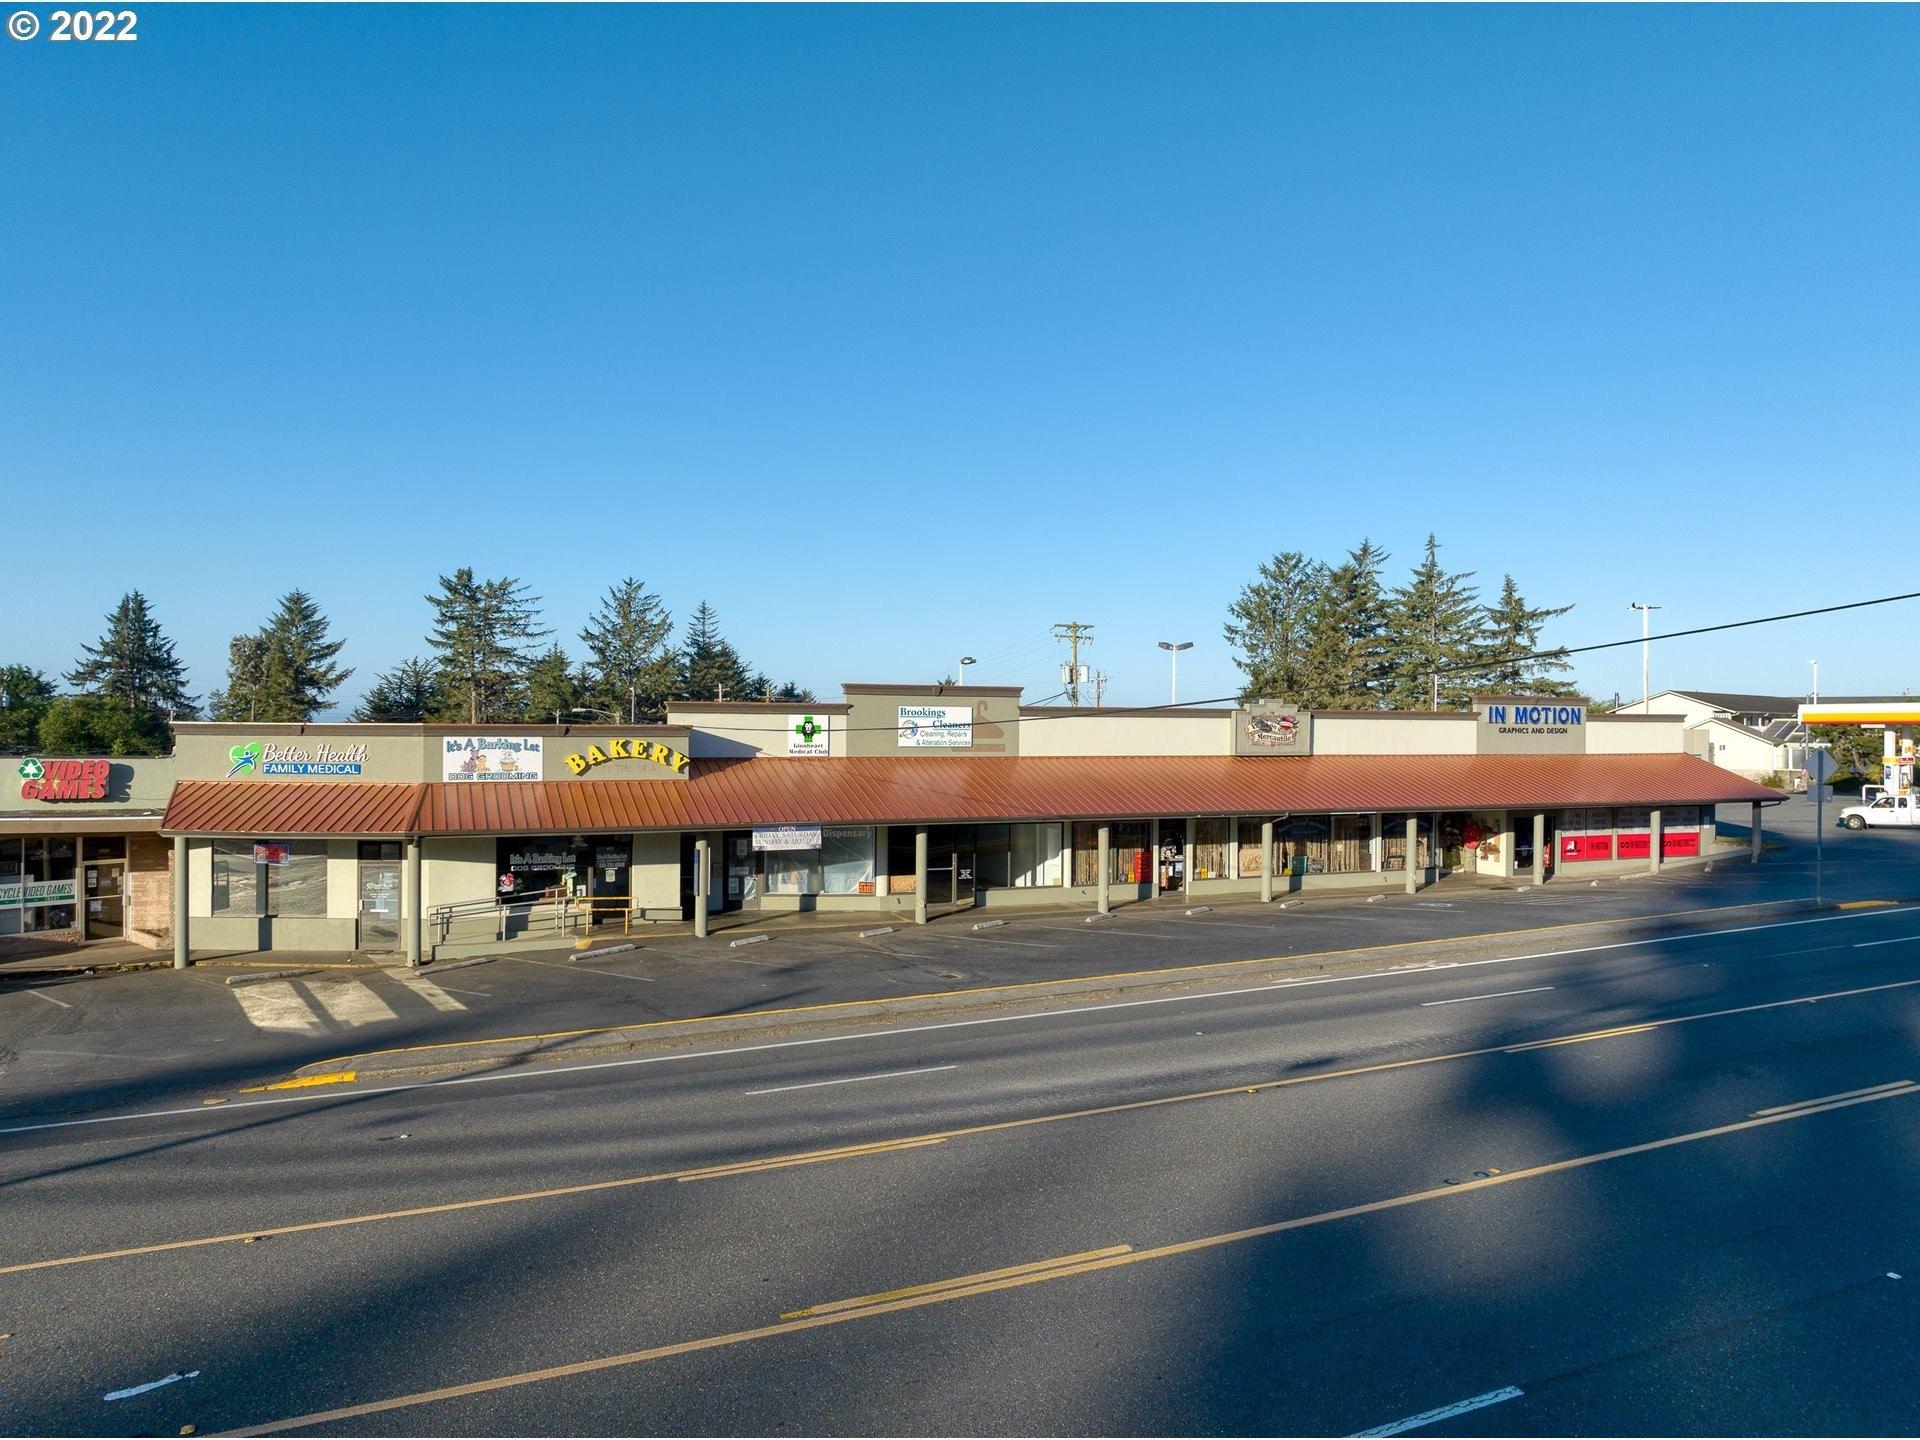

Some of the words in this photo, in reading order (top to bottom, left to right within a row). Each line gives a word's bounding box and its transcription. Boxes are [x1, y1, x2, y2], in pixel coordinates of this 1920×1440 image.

[900, 707, 946, 719] Brookings
[1489, 706, 1506, 724] IN
[1515, 706, 1581, 725] MOTION
[933, 720, 971, 729] Cleaners
[446, 740, 462, 752] It's
[463, 738, 475, 751] A
[477, 738, 522, 752] Barking
[524, 739, 540, 752] Lot
[263, 744, 311, 762] Better
[317, 744, 369, 762] Health
[564, 739, 690, 776] BAKERY
[42, 760, 110, 780] VIDEO
[263, 764, 305, 774] FAMILY
[308, 764, 359, 774] MEDICAL
[477, 772, 538, 780] GROOMING
[21, 780, 106, 800] GAMES
[823, 828, 872, 839] Dispensary
[523, 853, 532, 864] A
[532, 853, 562, 865] Barking
[24, 885, 46, 897] VIDEO
[46, 883, 73, 896] GAMES
